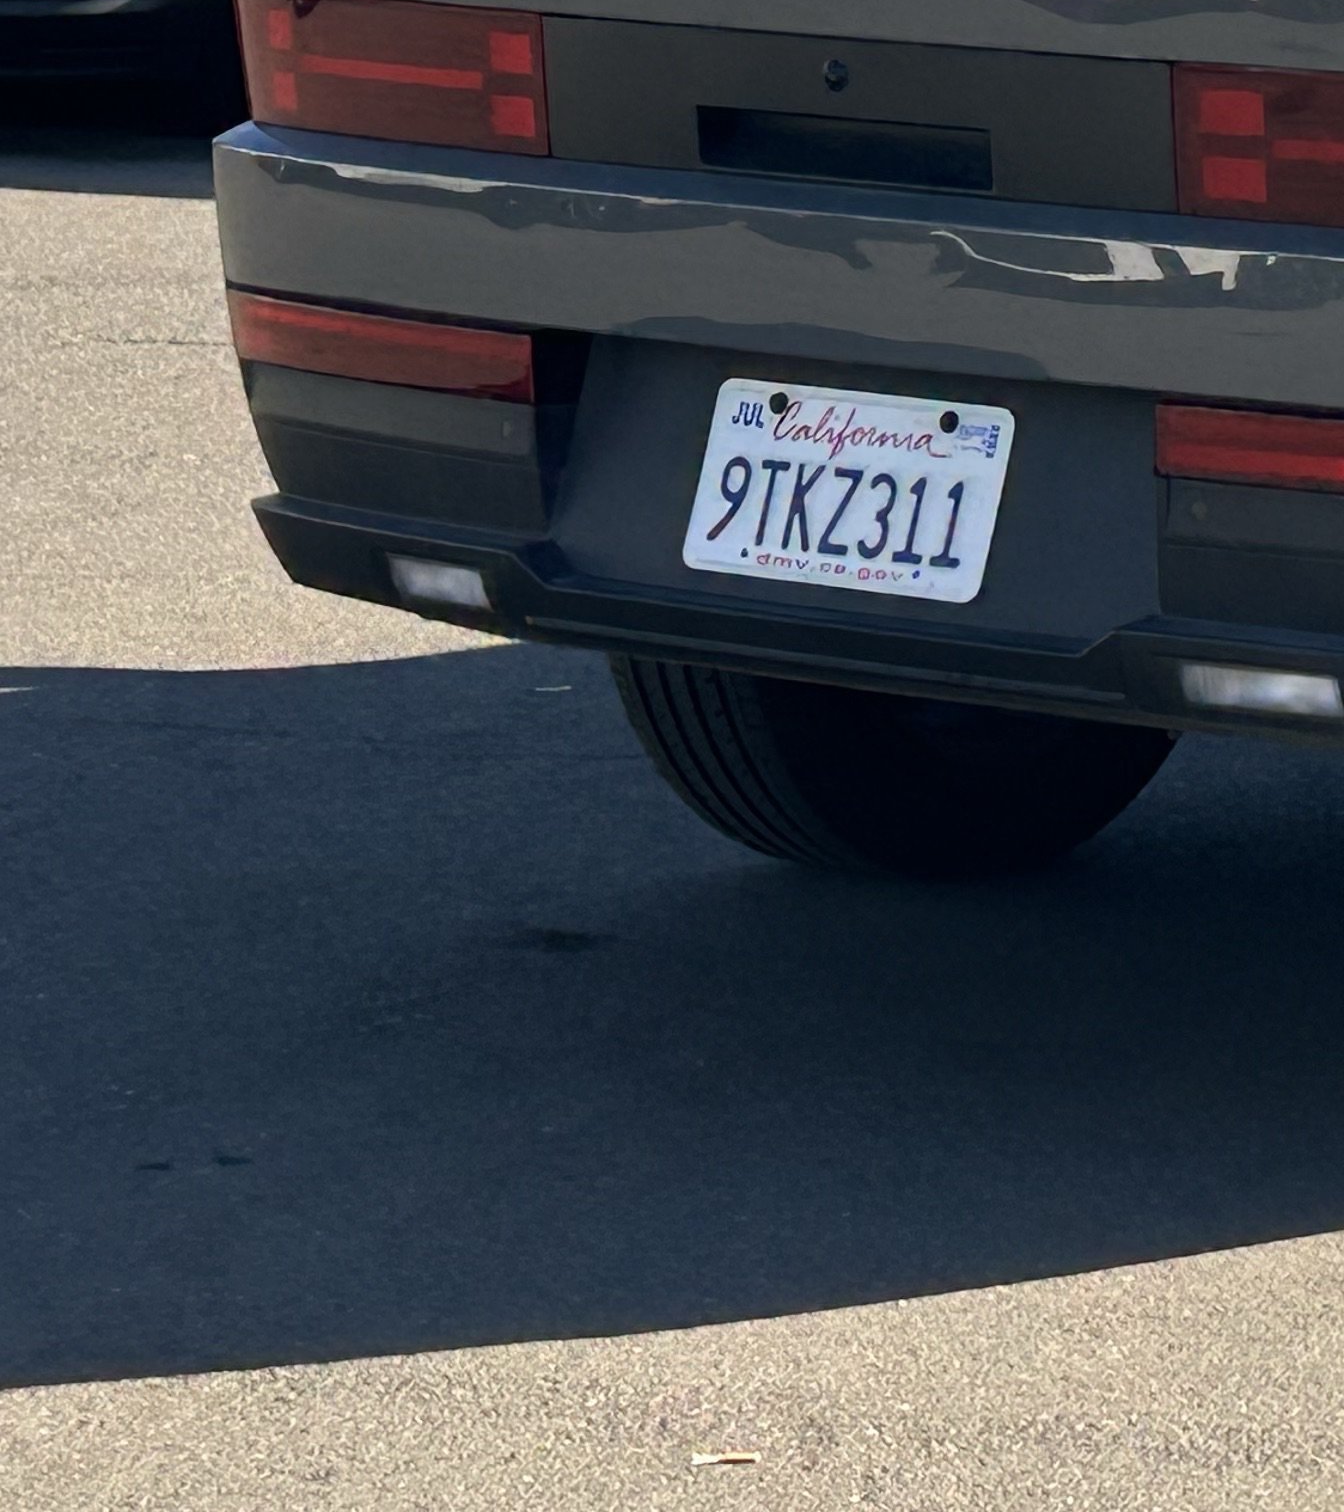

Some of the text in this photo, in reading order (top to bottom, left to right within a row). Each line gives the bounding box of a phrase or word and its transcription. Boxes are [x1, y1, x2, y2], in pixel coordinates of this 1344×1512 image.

[731, 400, 765, 429] JUL
[772, 400, 953, 460] California
[705, 455, 966, 569] 9TKZ311
